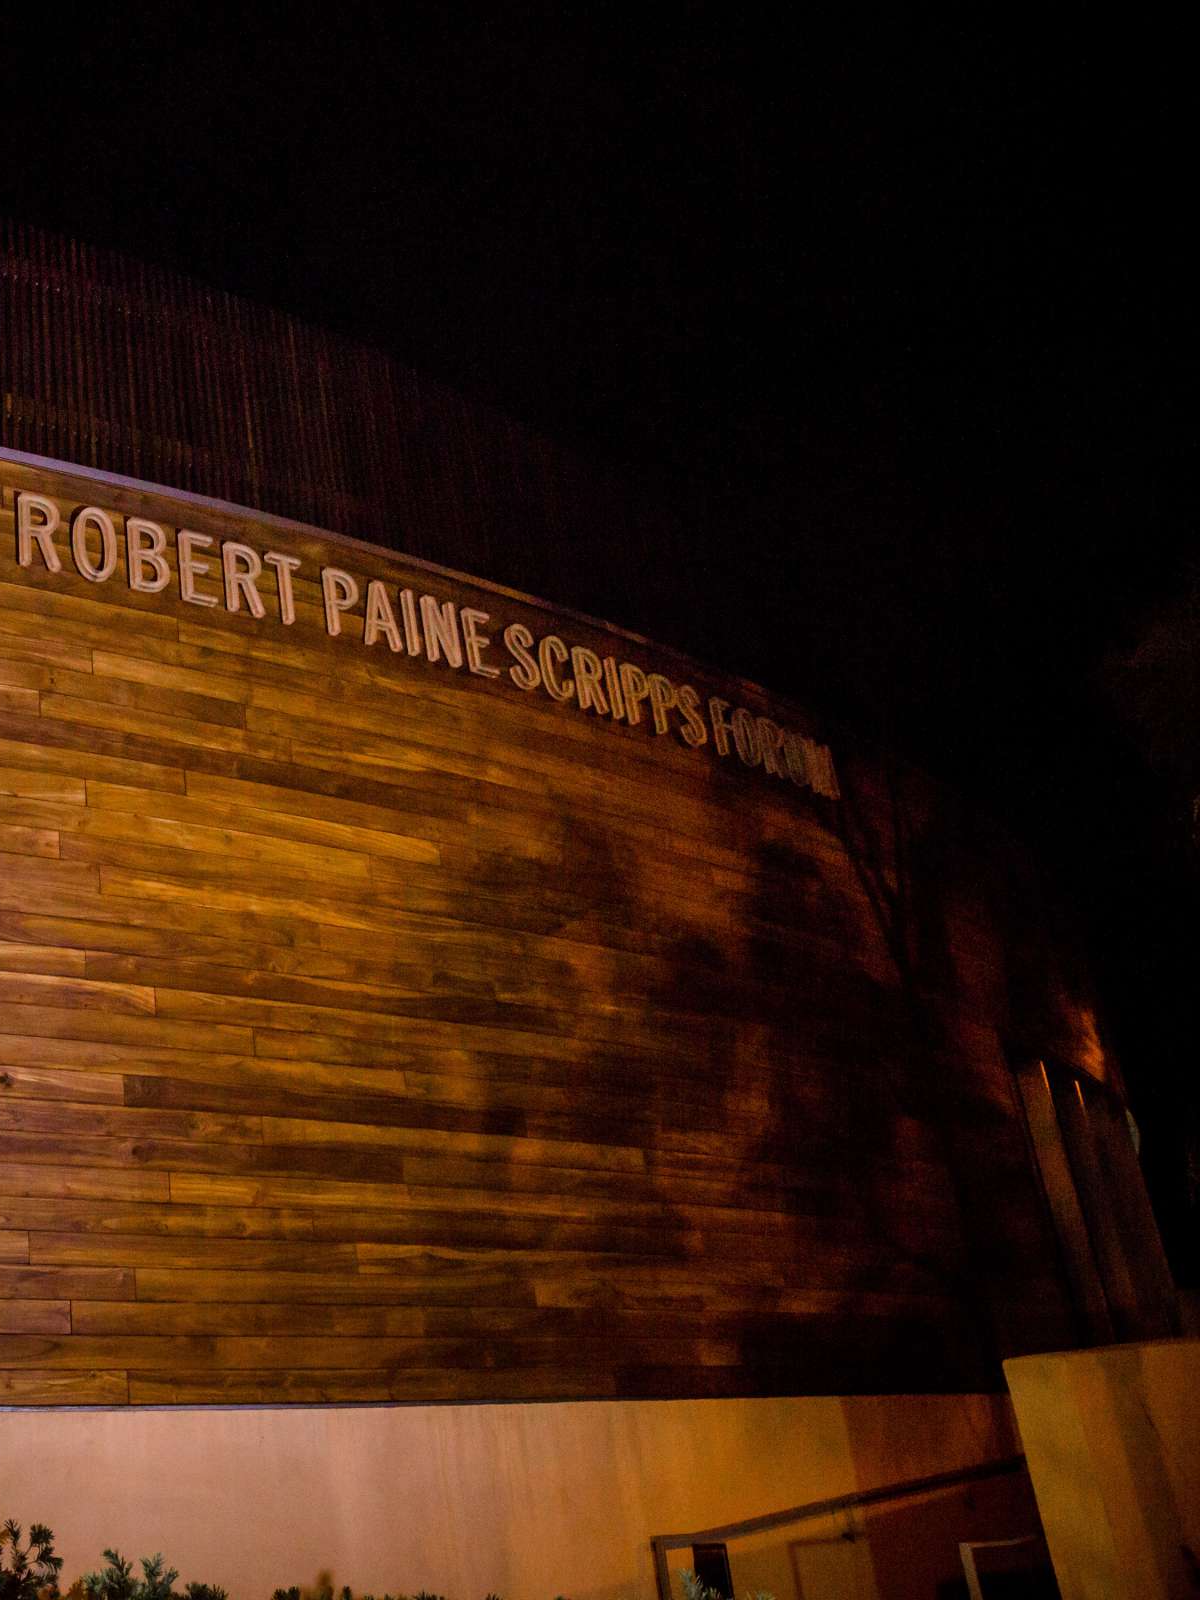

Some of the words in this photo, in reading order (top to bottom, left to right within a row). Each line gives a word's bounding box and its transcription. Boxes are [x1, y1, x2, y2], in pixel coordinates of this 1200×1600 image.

[17, 491, 301, 626] ROBERT
[322, 567, 501, 679] PAINE
[503, 623, 708, 748] SCRIPPS
